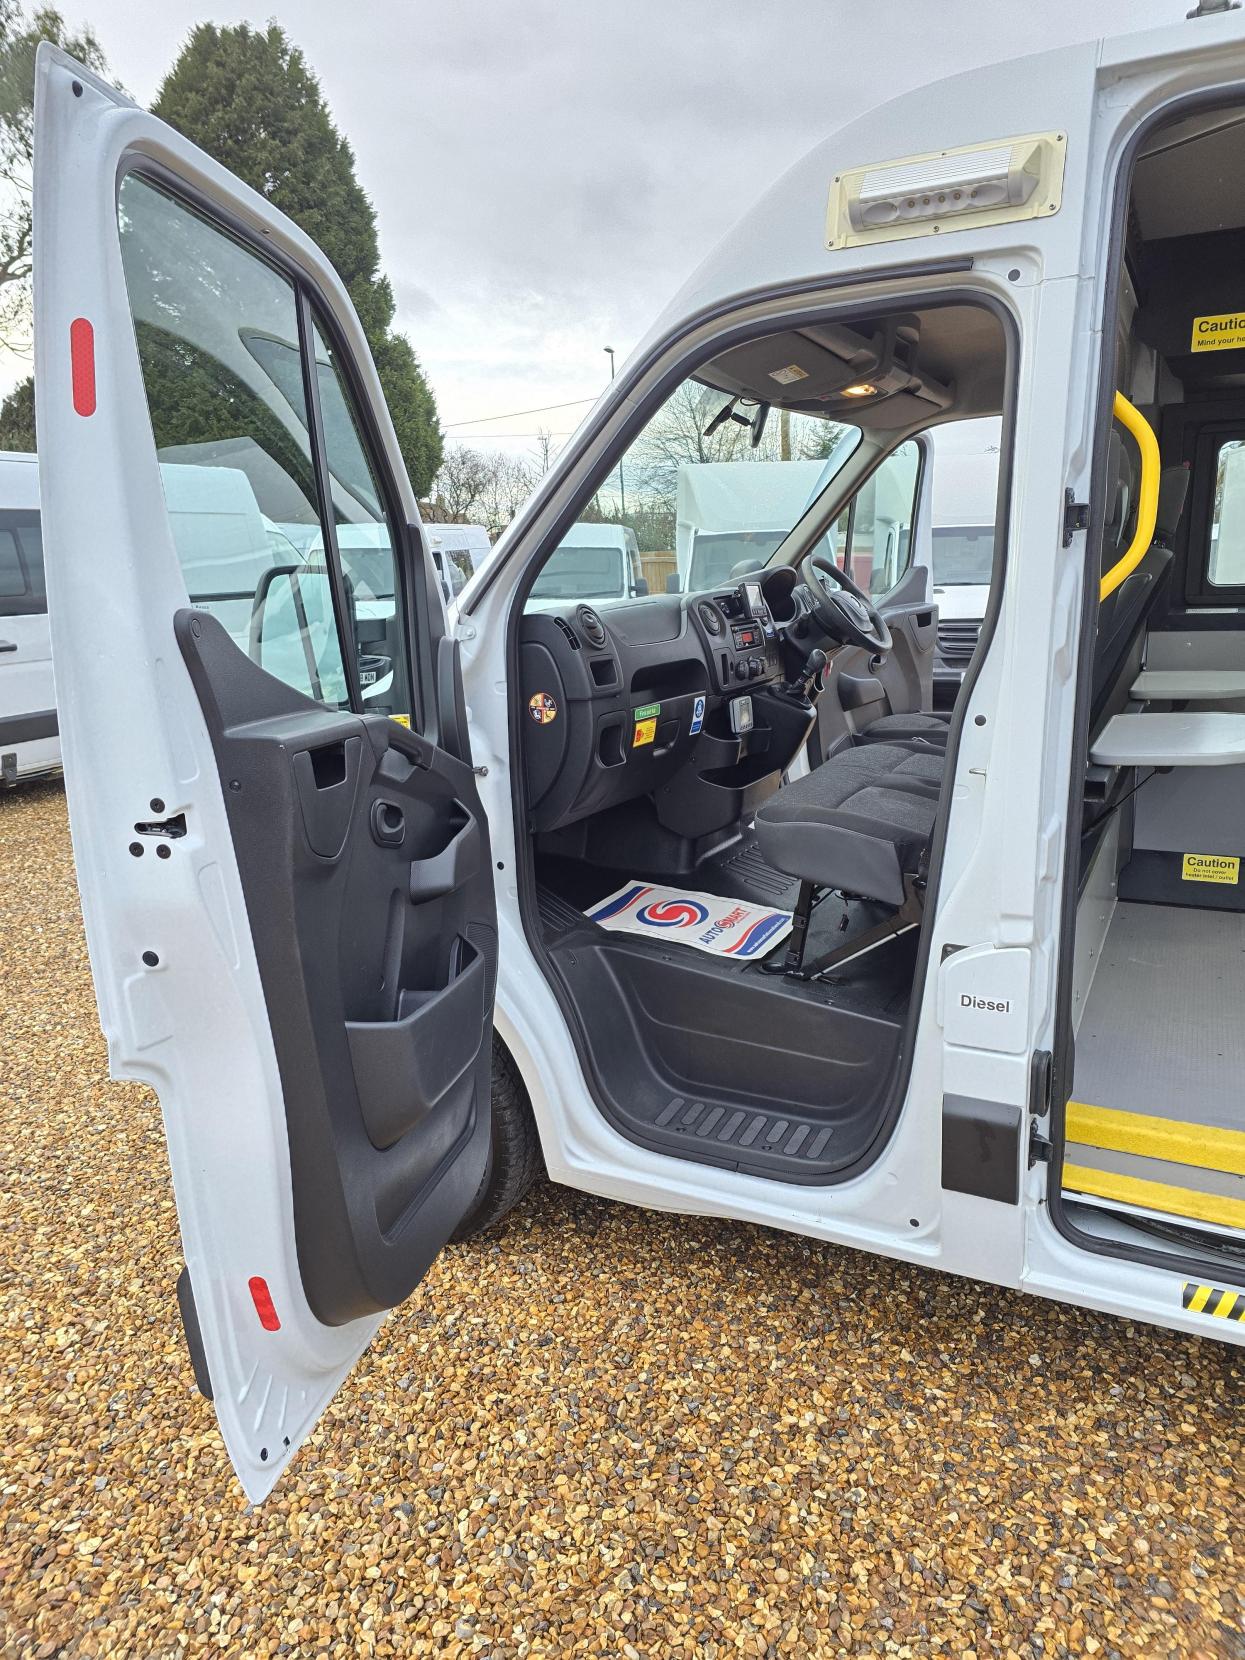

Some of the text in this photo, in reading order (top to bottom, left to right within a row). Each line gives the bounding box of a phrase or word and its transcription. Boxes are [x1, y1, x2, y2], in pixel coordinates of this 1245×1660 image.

[1197, 339, 1216, 347] Mind
[1187, 857, 1235, 869] Caution
[961, 994, 1010, 1013] Diesel
